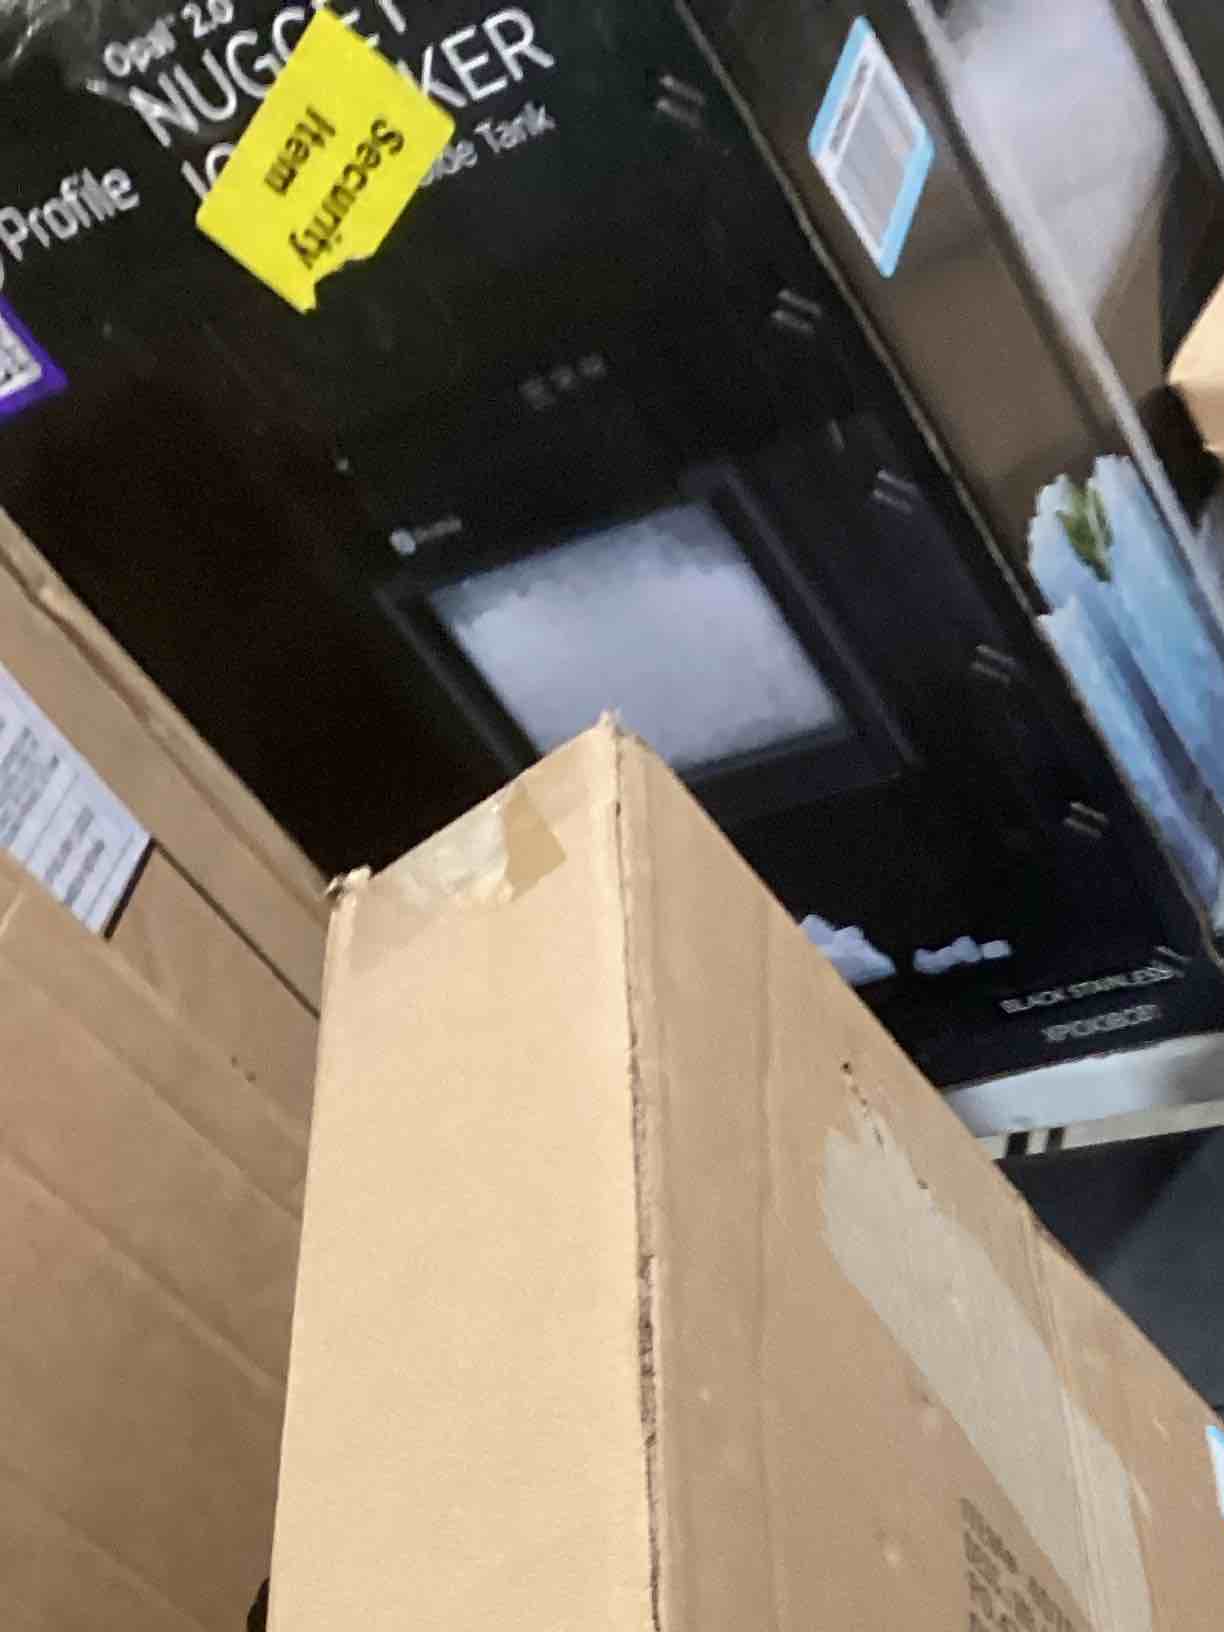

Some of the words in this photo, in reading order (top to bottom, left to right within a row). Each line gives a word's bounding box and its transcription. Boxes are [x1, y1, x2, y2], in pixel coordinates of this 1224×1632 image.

[397, 7, 555, 108] KER
[264, 105, 336, 196] Item
[288, 118, 404, 270] Security
[0, 167, 140, 262] Profile
